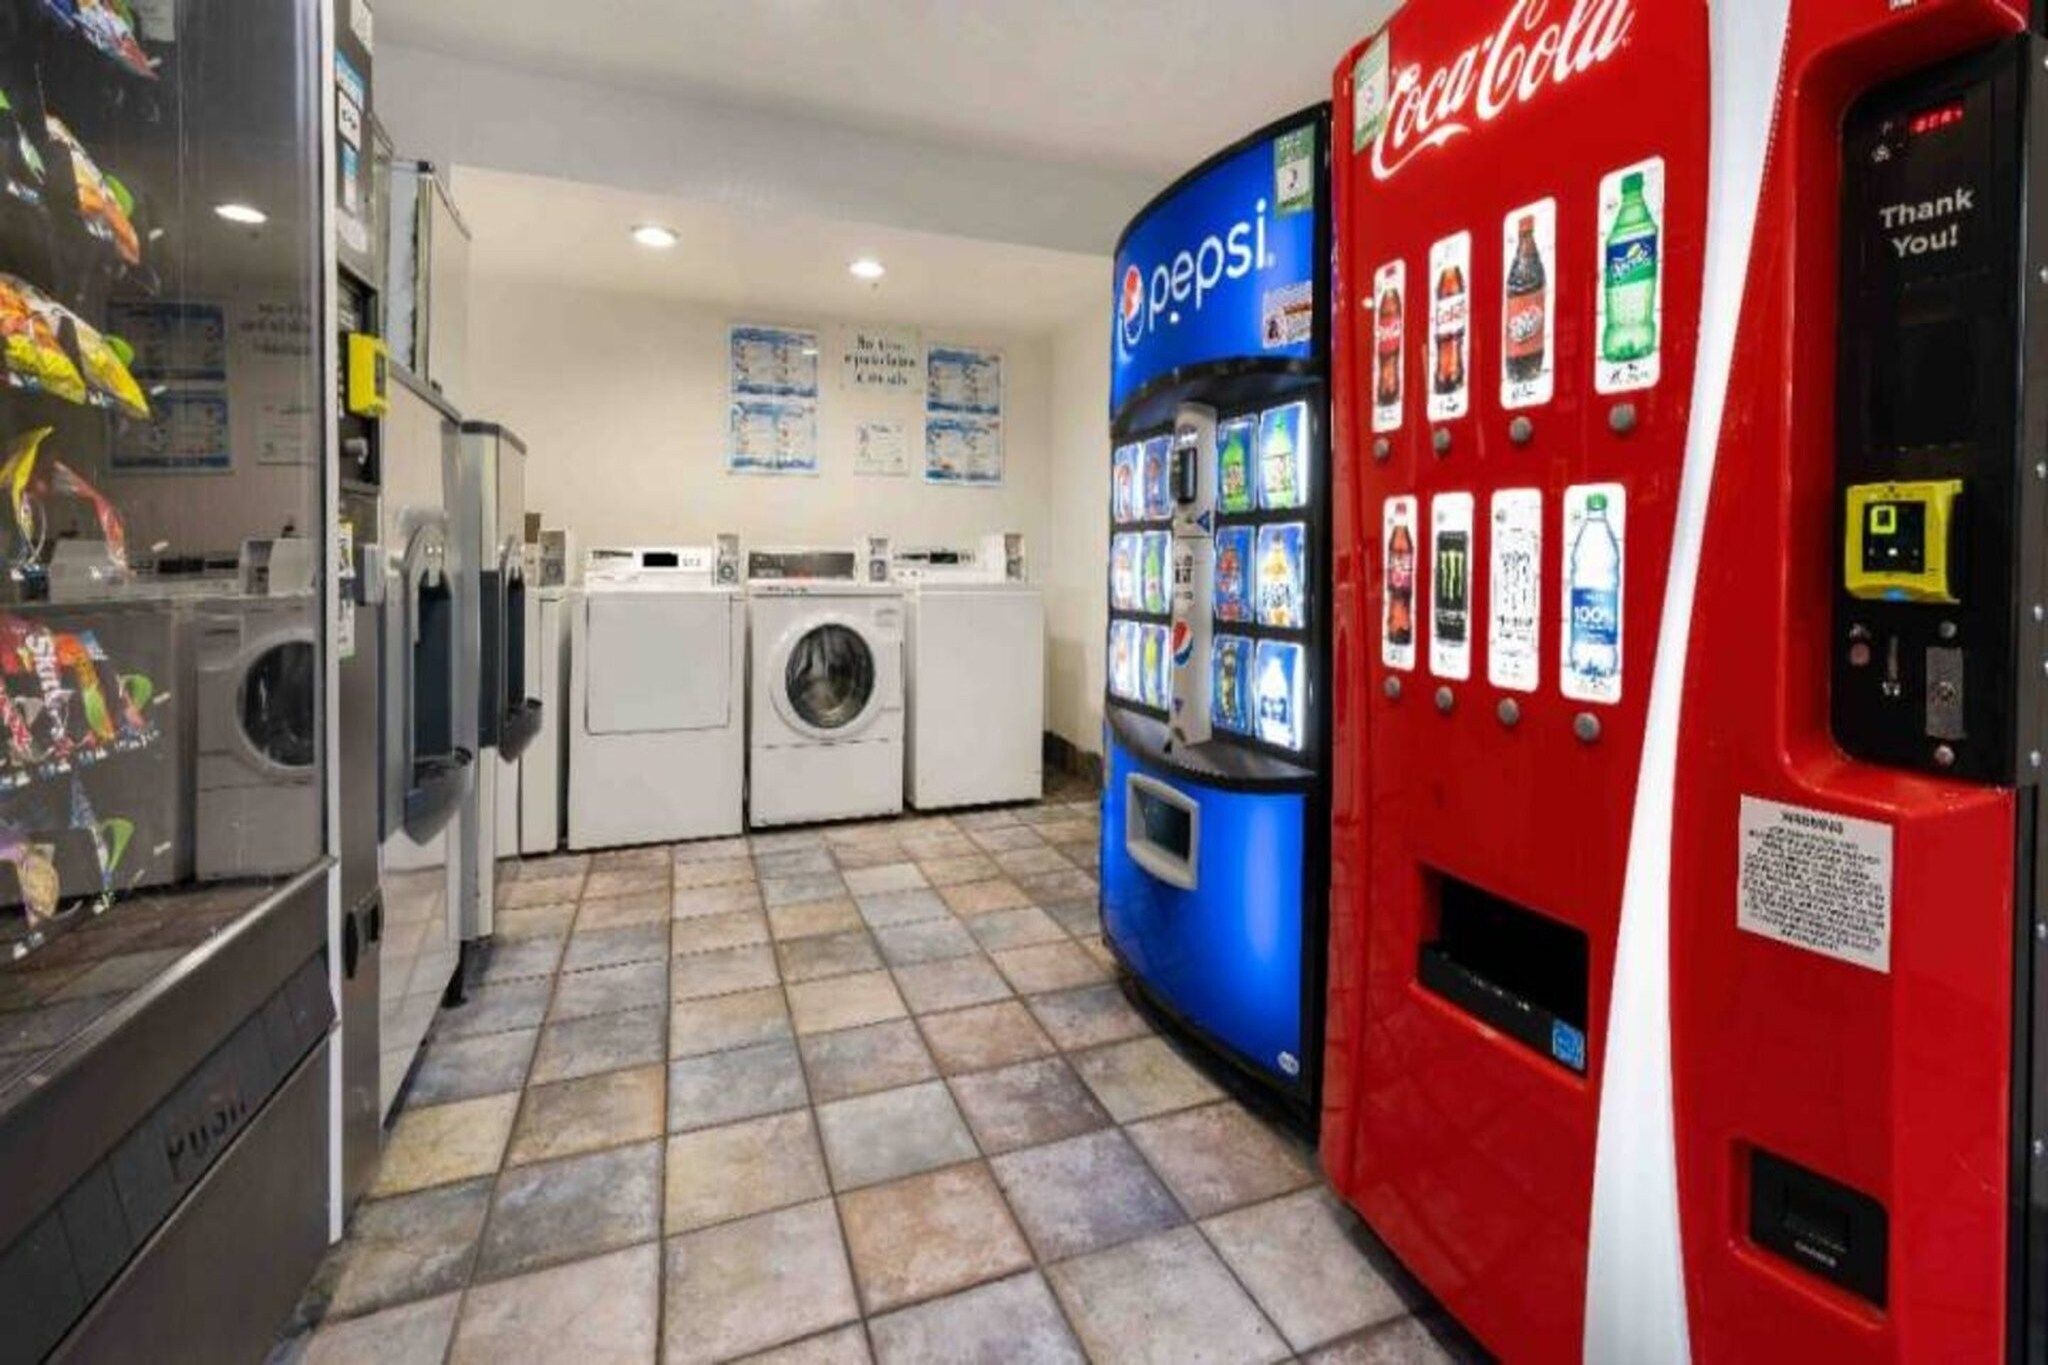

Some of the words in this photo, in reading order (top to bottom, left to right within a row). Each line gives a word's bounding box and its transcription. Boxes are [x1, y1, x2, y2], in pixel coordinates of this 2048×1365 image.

[1371, 0, 1636, 180] Coca-Cola
[1879, 186, 1975, 230] Thank
[1893, 226, 1958, 258] You!
[1149, 198, 1268, 333] pepsi
